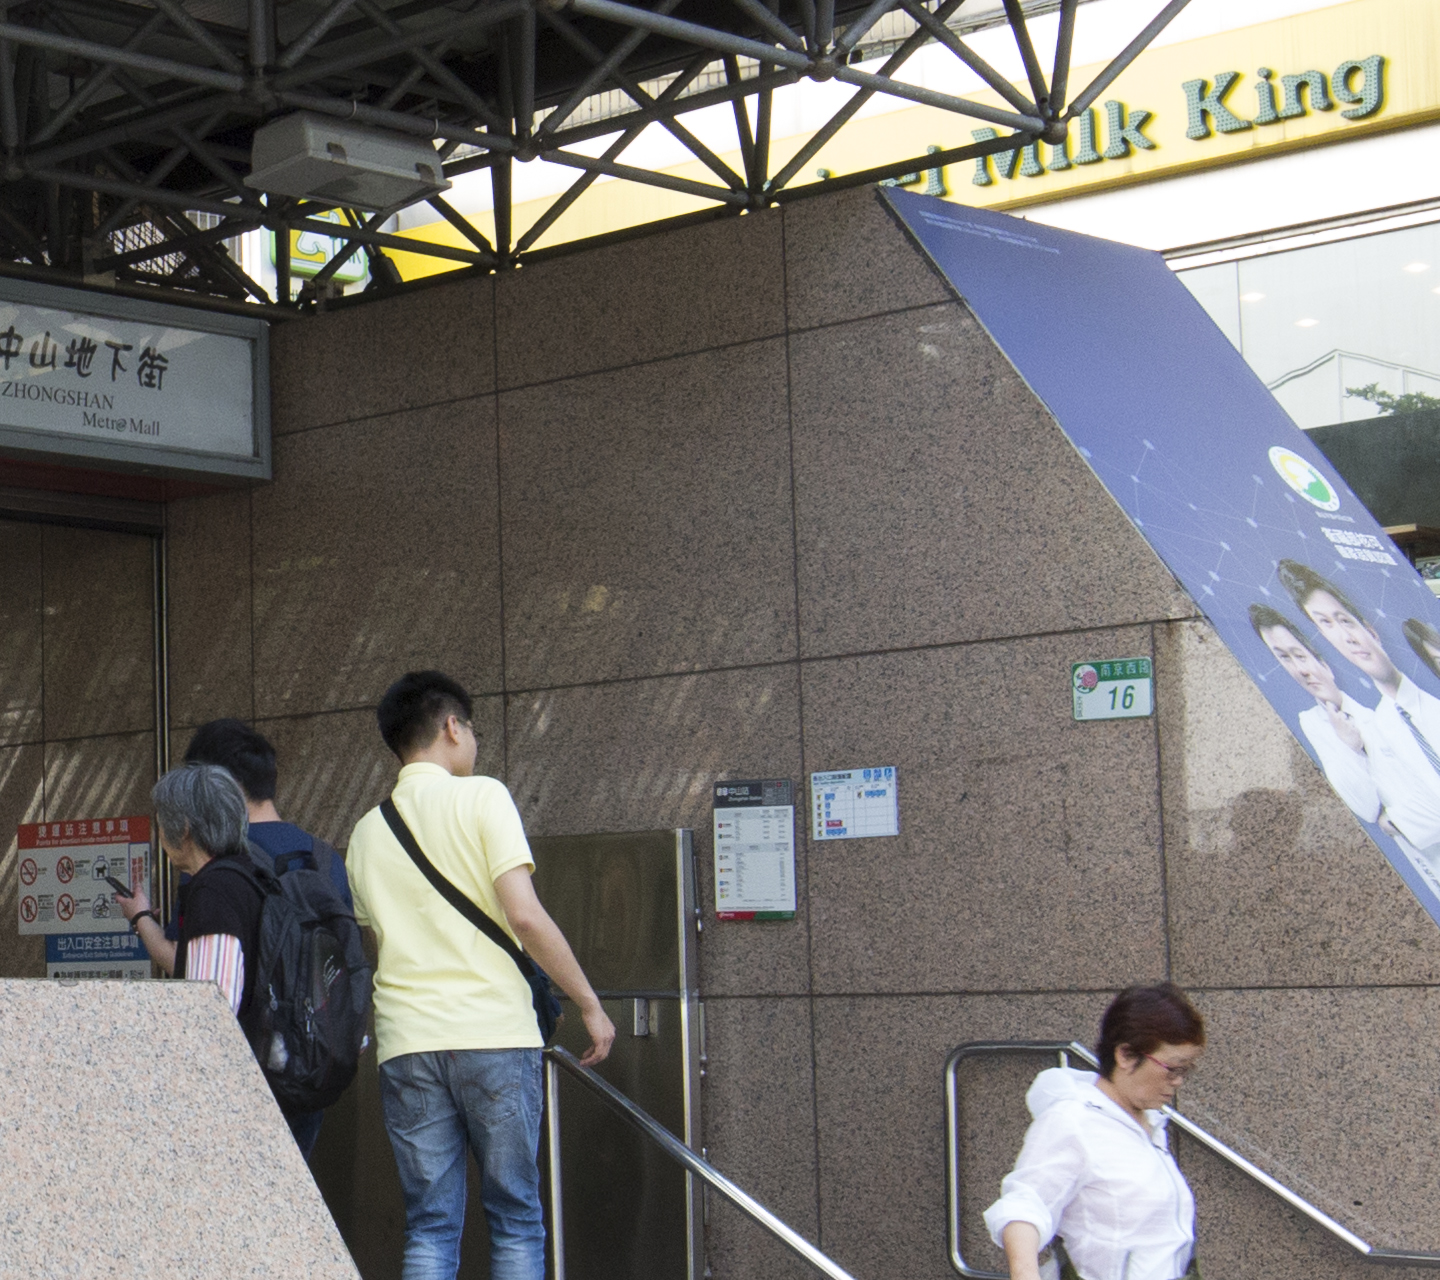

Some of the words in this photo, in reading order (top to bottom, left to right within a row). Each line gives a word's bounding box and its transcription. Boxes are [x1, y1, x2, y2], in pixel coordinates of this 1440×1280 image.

[1182, 54, 1385, 140] King
[1, 380, 115, 410] ZHONGSHAN
[129, 417, 160, 437] Mall
[1101, 661, 1149, 677] 南京西路
[1109, 685, 1135, 710] 16
[38, 819, 128, 838] 捷運站注意事項
[58, 934, 138, 951] 出入口安全注意事項
